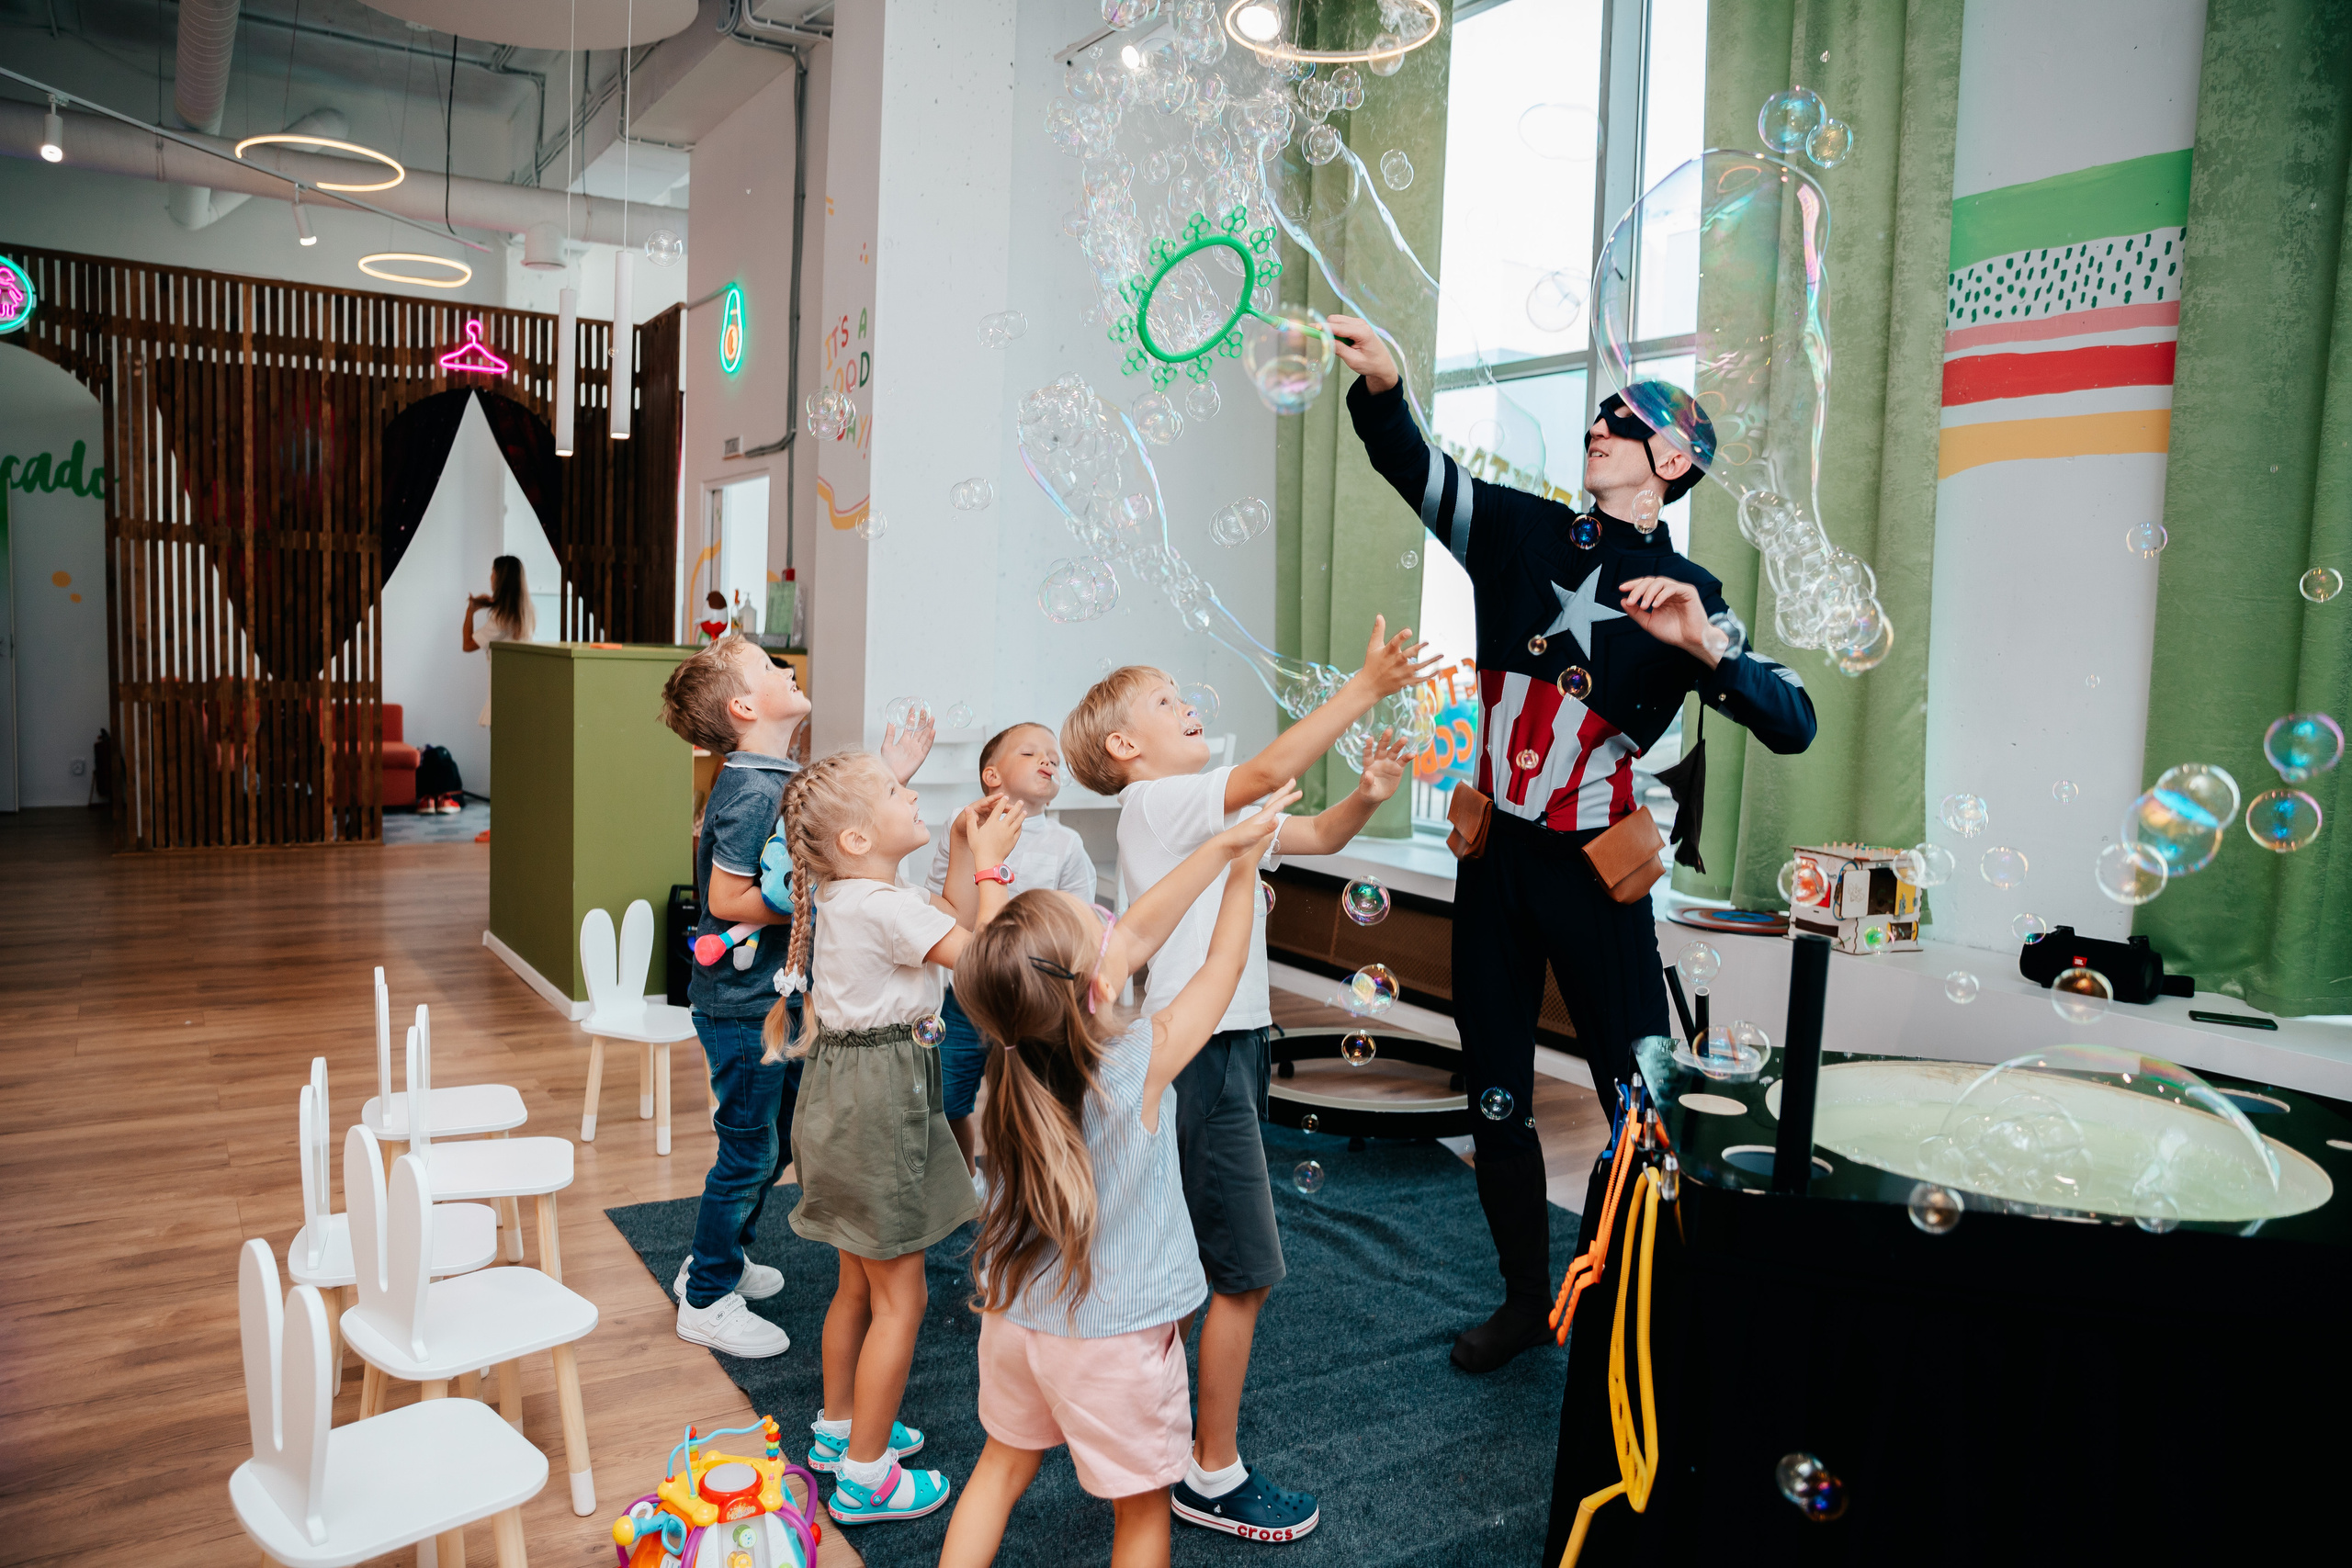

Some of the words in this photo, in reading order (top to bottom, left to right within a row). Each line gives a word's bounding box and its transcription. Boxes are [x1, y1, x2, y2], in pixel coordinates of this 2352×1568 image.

[824, 314, 849, 371] IT'S
[857, 306, 868, 340] A
[1237, 1524, 1294, 1541] crocs
